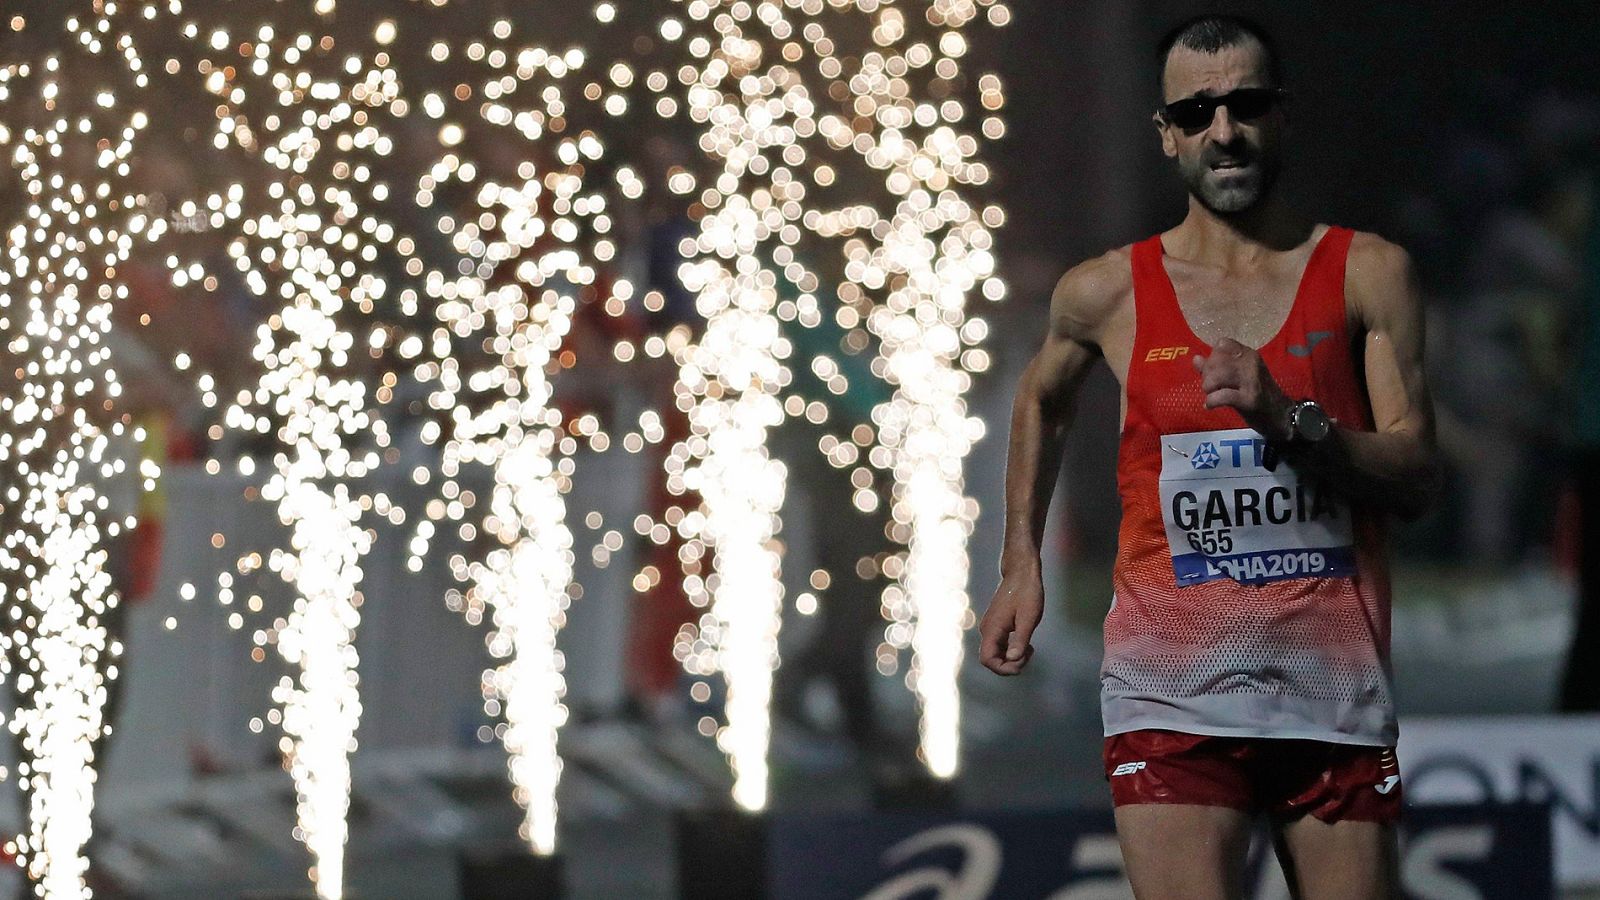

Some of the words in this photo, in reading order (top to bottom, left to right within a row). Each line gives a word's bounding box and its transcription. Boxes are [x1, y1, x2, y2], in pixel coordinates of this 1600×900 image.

[1145, 346, 1190, 362] ESP
[1187, 529, 1233, 555] 655
[1111, 761, 1147, 776] ESP
